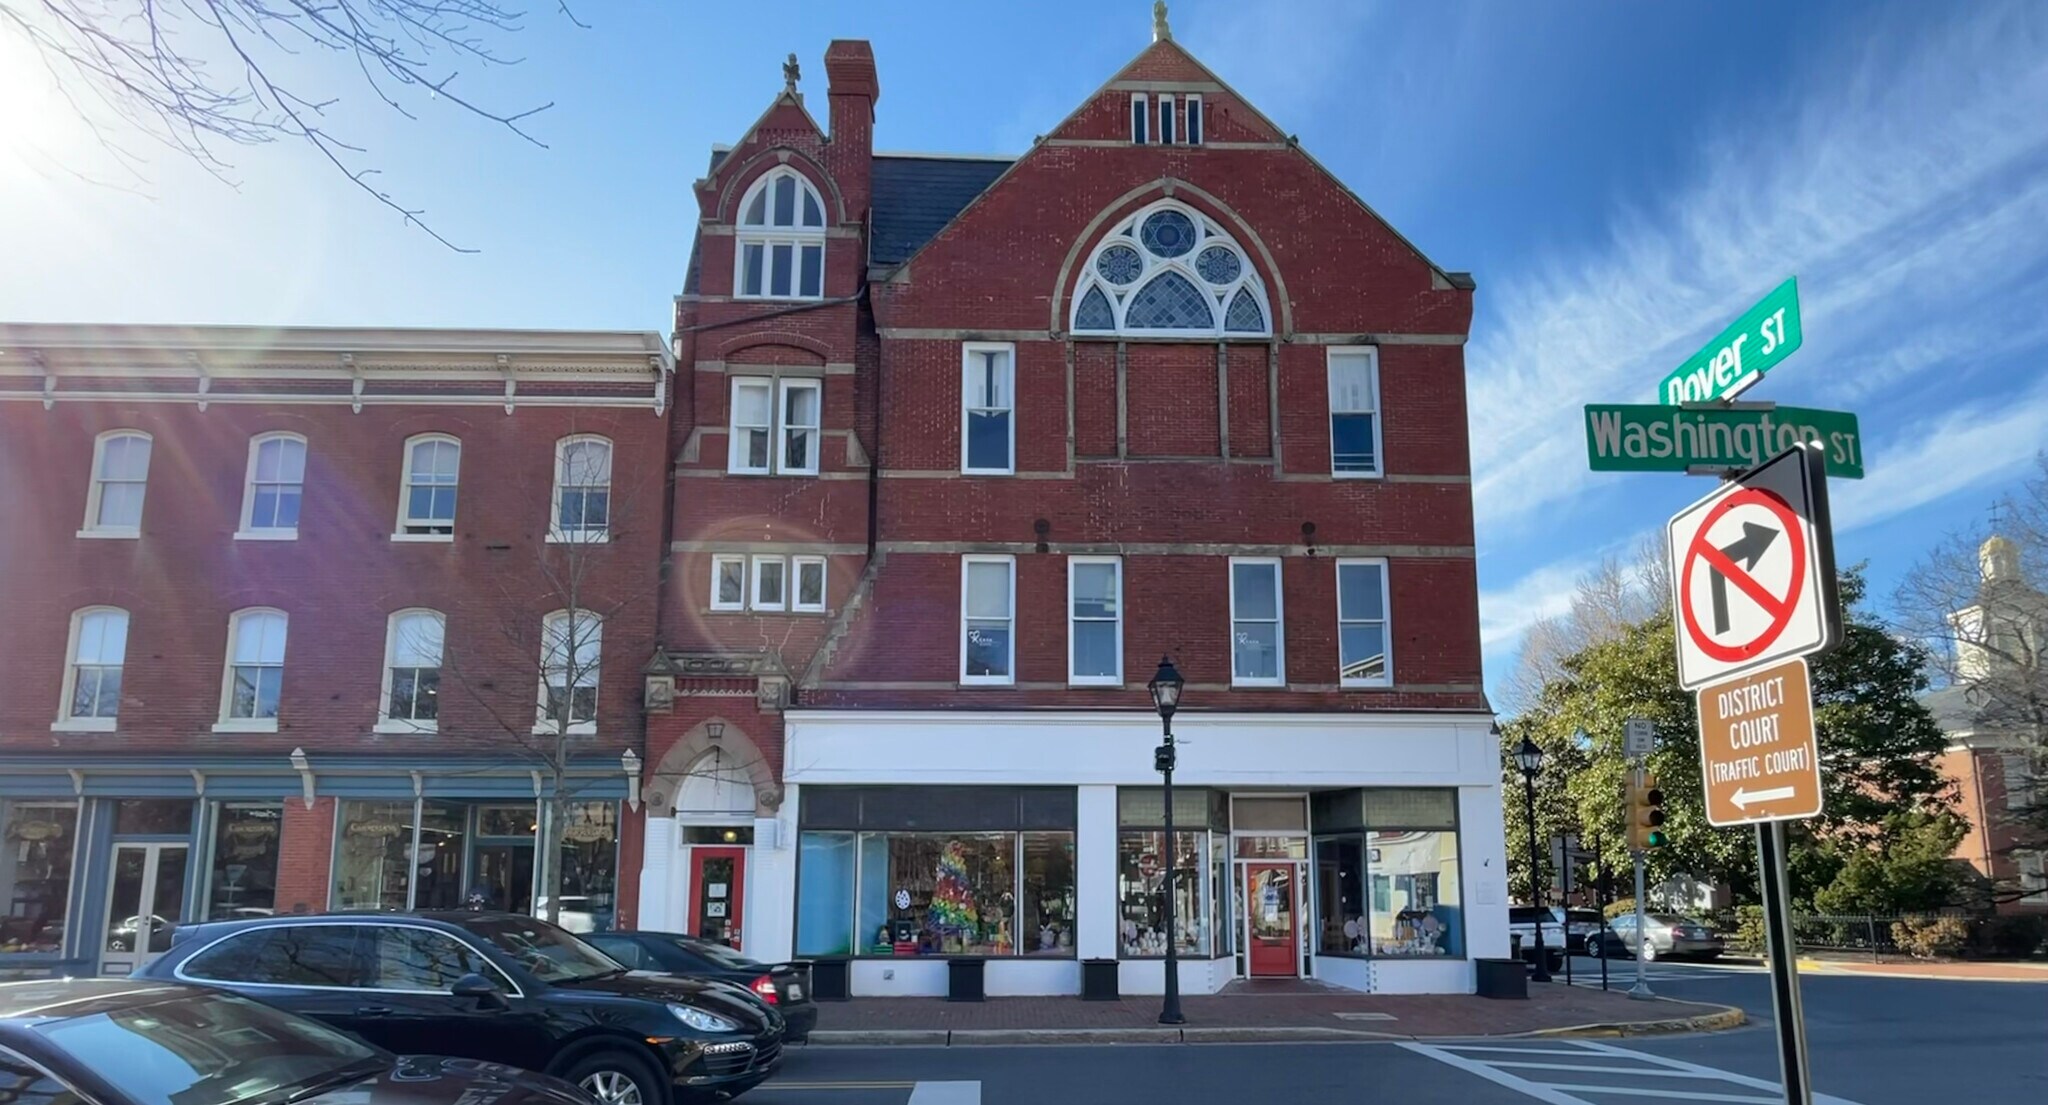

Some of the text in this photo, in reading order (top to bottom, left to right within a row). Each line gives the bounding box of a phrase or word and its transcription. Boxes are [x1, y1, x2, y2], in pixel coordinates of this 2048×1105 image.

[1667, 307, 1786, 406] Dover ST
[1589, 410, 1856, 466] Washington ST
[1717, 676, 1784, 720] DISTRICT
[1634, 722, 1647, 730] NO
[1729, 713, 1780, 750] COURT
[1709, 741, 1811, 787] (TRAFFIC COURT)
